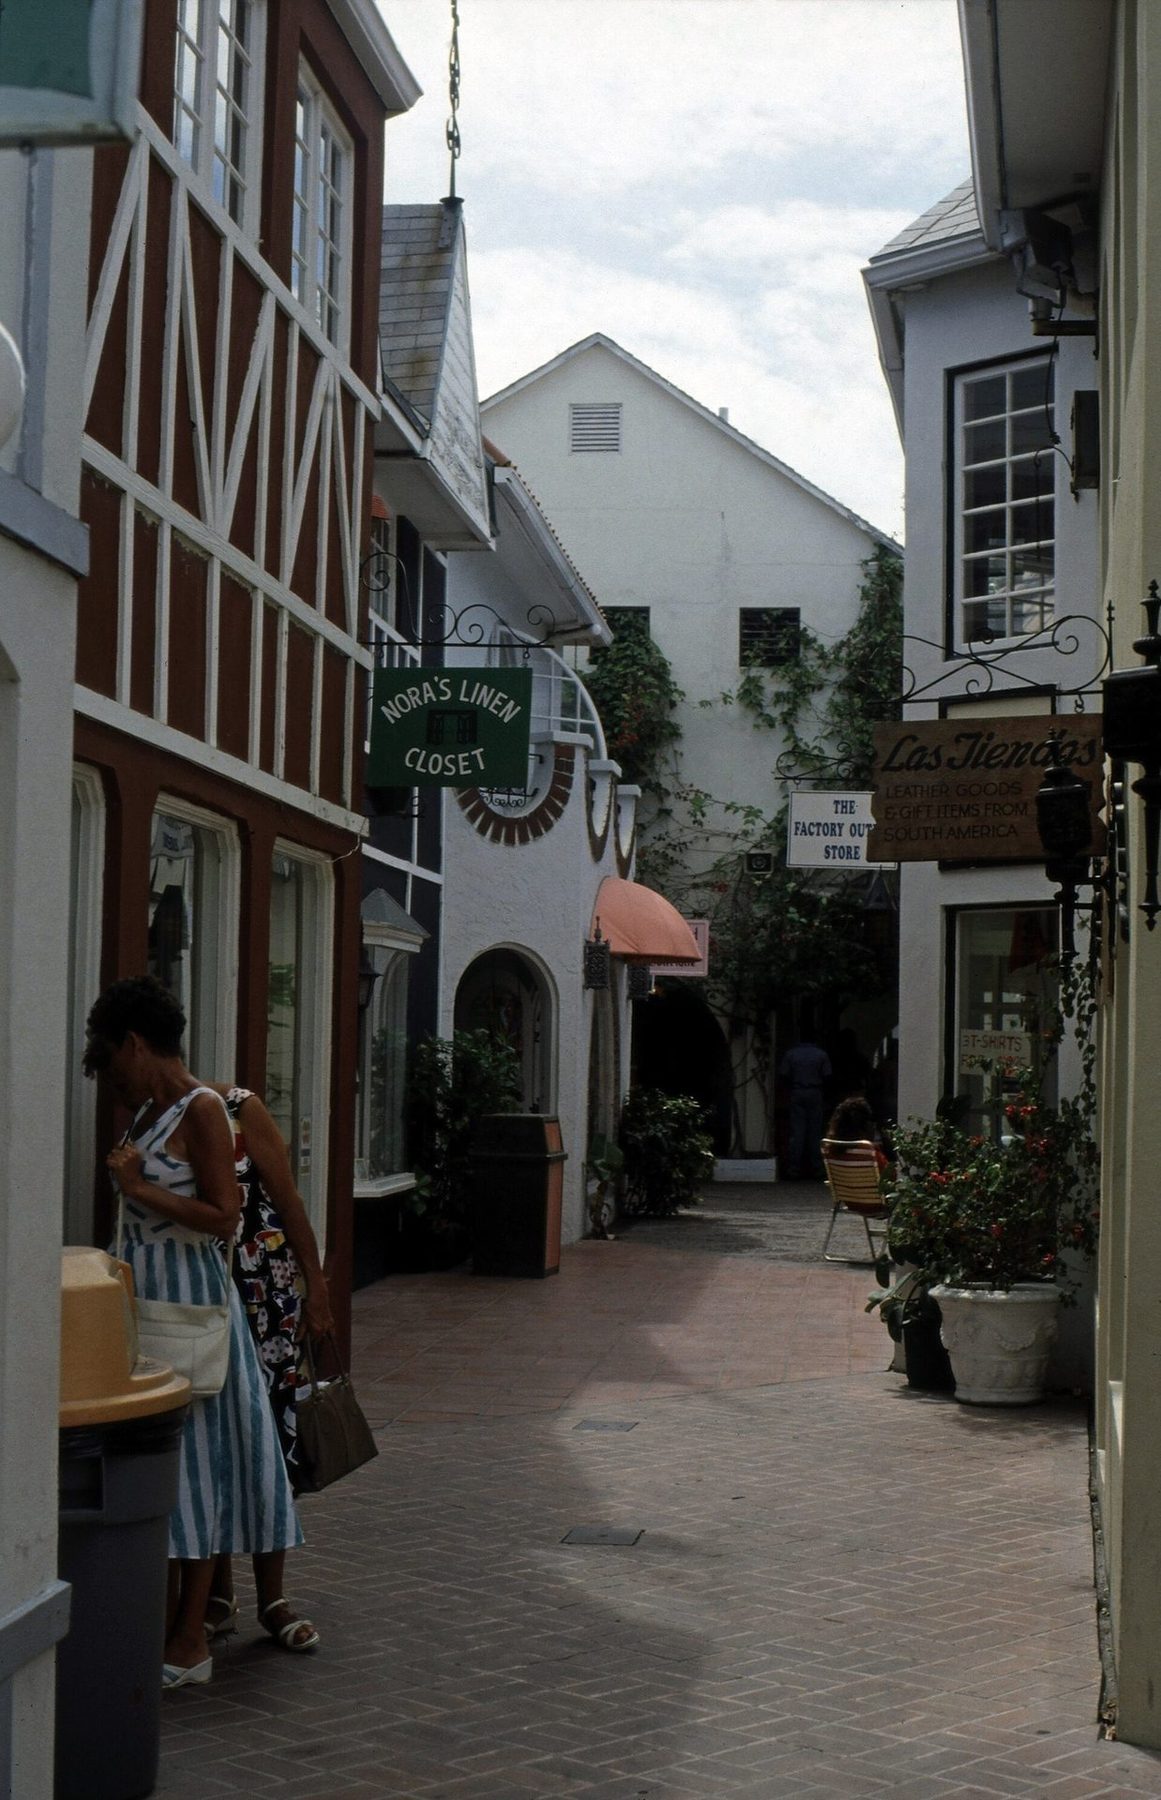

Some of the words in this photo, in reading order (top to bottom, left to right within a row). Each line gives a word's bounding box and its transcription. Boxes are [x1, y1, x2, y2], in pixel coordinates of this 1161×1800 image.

[381, 676, 451, 724] NORA'S
[459, 679, 521, 723] LINEN
[405, 748, 485, 776] CLOSET
[880, 734, 942, 772] Las
[886, 783, 950, 799] LEATHER
[956, 781, 1023, 797] GOODS
[833, 800, 856, 814] THE
[884, 806, 897, 820] &
[900, 804, 932, 819] GIFT
[936, 803, 980, 818] ITEMS
[984, 802, 1028, 817] FROM
[794, 822, 844, 837] FACTORY
[884, 825, 943, 841] SOUTH
[945, 824, 1019, 840] AMERICA
[824, 845, 861, 860] STORE
